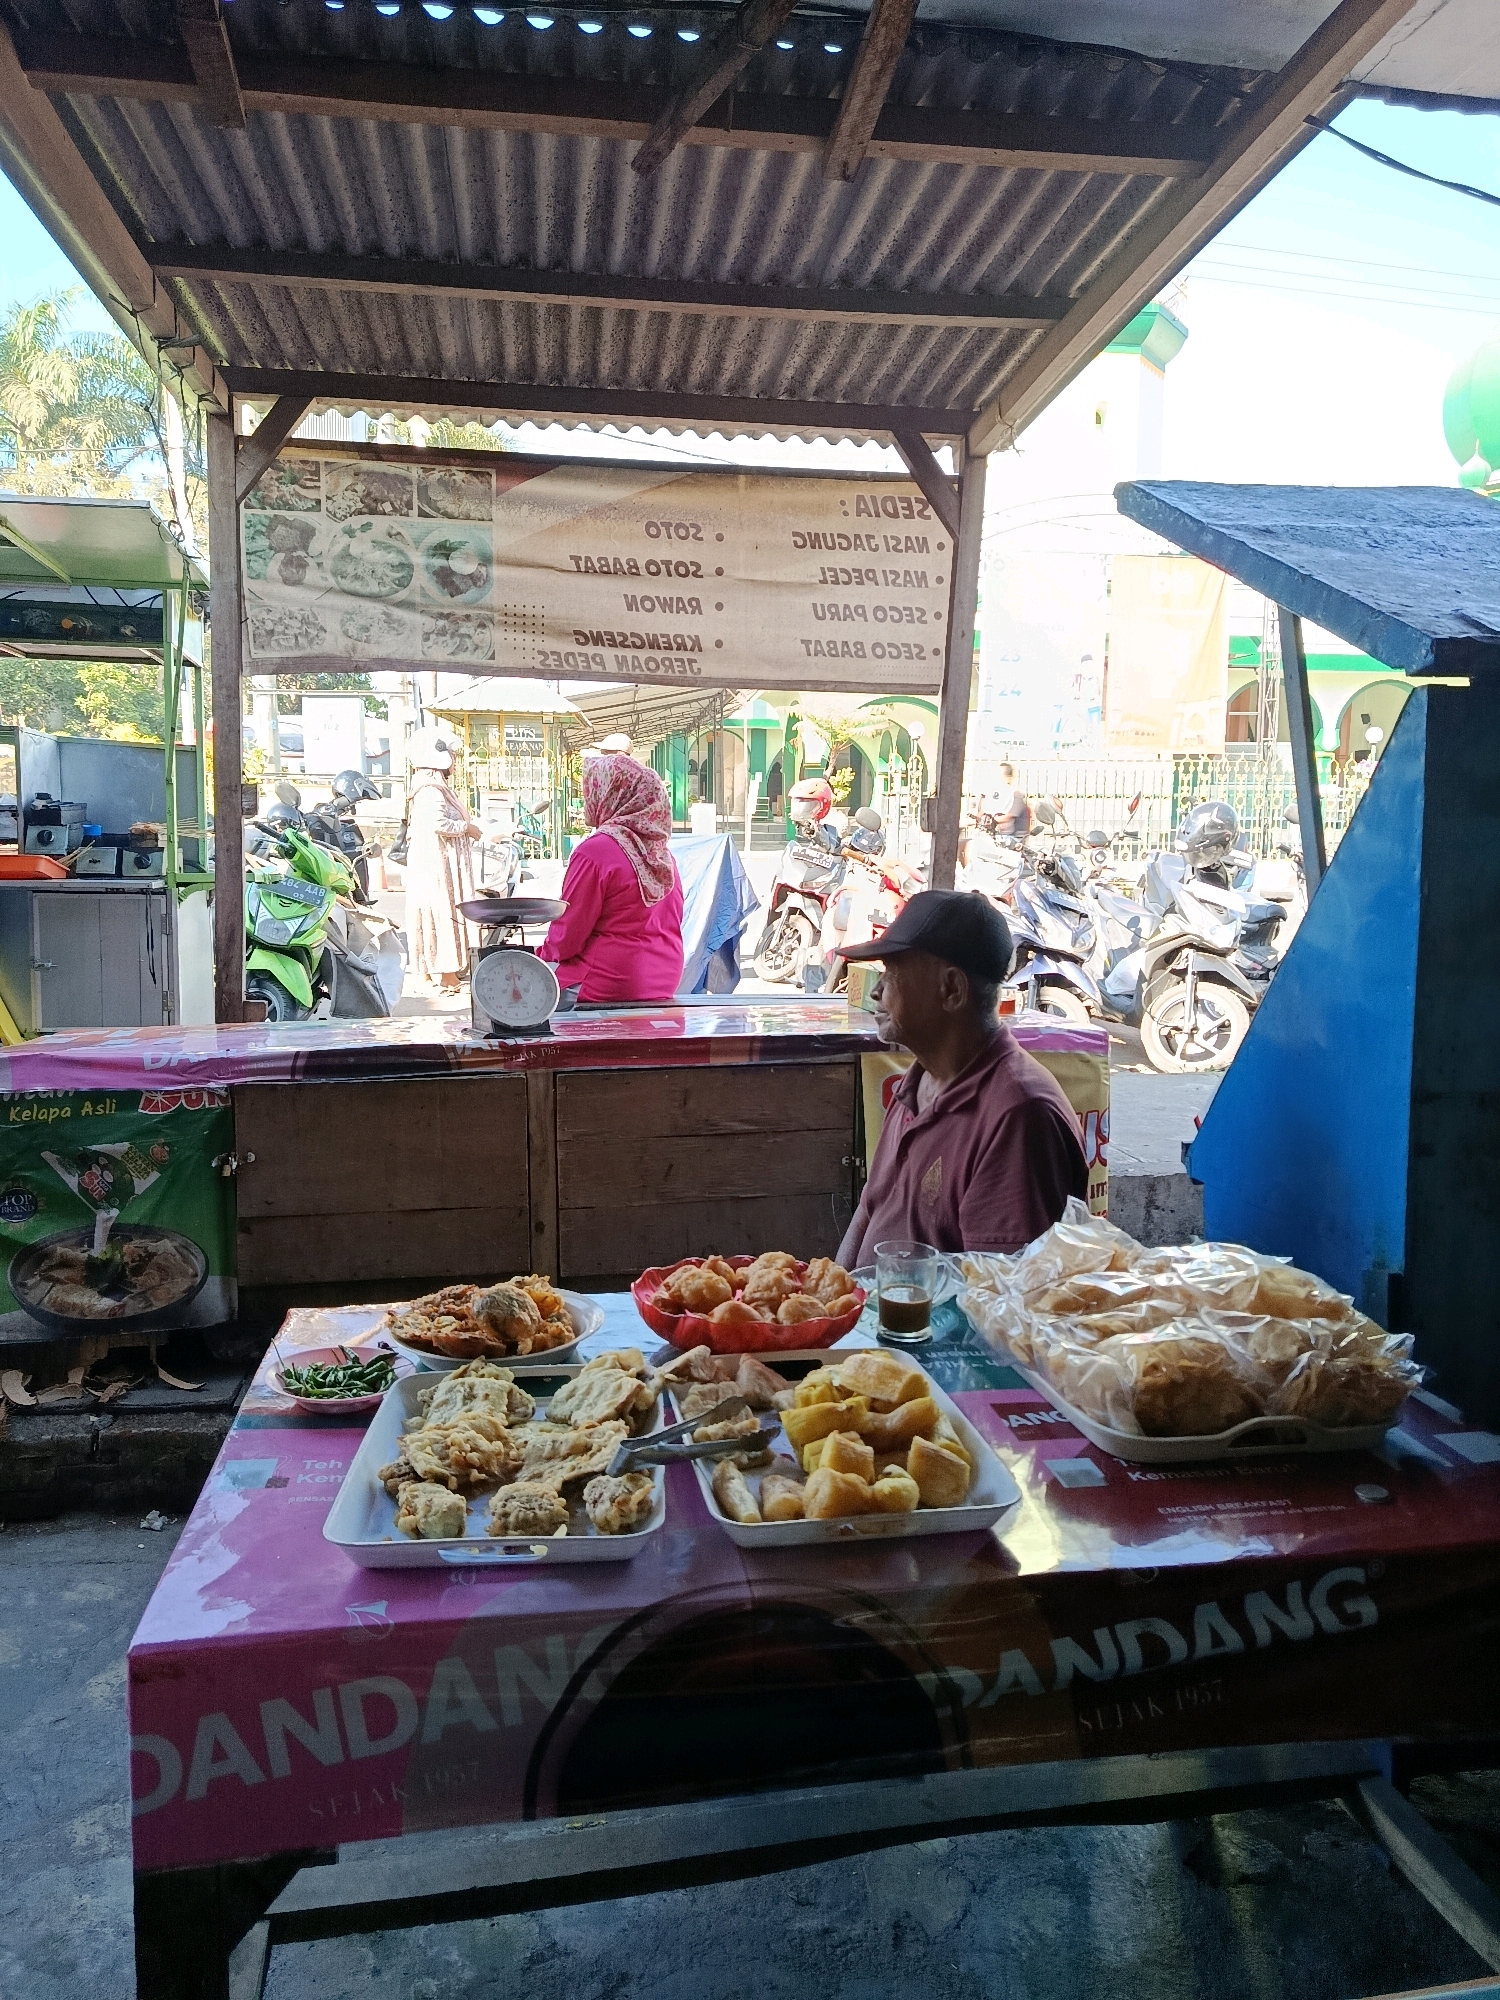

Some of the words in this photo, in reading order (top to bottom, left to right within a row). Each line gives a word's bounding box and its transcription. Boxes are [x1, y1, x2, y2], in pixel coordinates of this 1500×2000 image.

[9, 1104, 71, 1124] Kelapa
[81, 1098, 117, 1116] Asli
[4, 1194, 32, 1205] TOP
[1, 1205, 35, 1213] BRAND
[302, 1459, 342, 1469] Teh
